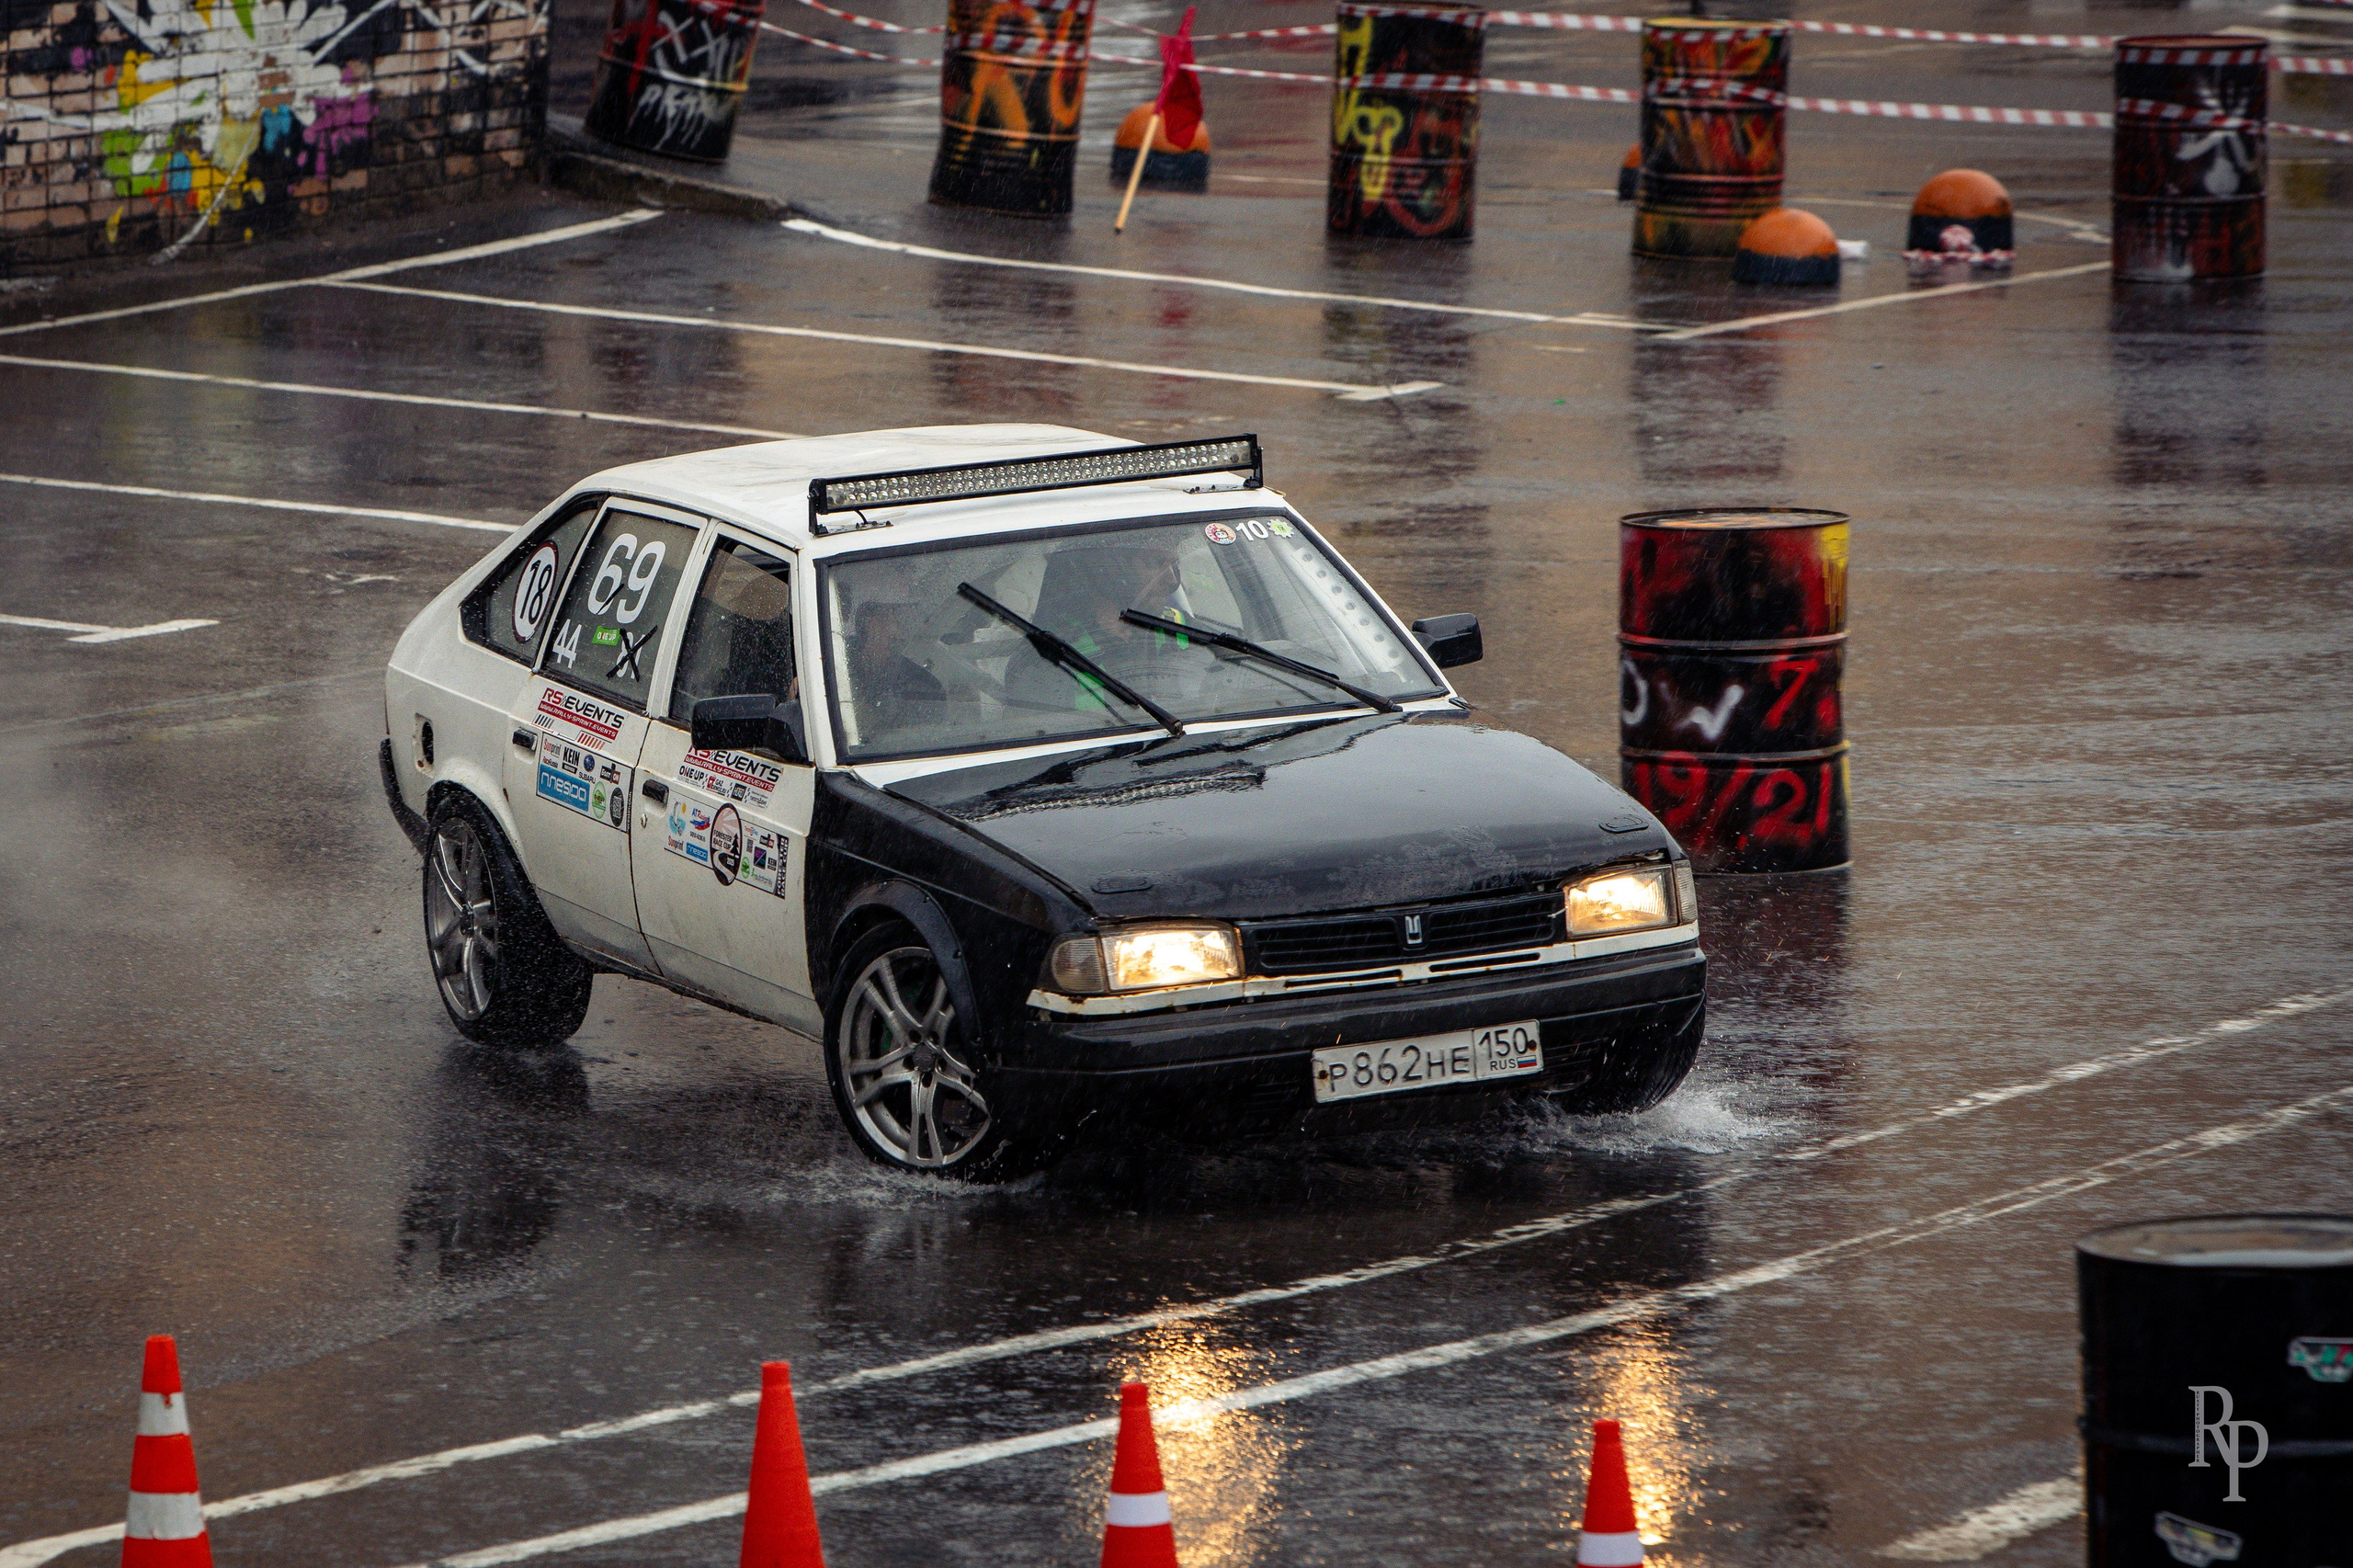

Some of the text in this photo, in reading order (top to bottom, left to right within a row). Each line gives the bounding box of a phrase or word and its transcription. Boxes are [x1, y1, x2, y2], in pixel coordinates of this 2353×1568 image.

[1235, 520, 1269, 541] 10
[588, 533, 665, 624] 69
[519, 560, 552, 625] 18
[551, 619, 582, 669] 44
[597, 631, 617, 642] ONE UP
[542, 687, 625, 729] RS EVENTS
[563, 746, 580, 767] KEIN
[714, 750, 781, 783] EVENTS
[578, 771, 597, 784] SUBARU
[679, 765, 705, 781] ONE UP
[713, 830, 733, 844] FORESTER
[713, 838, 733, 851] RACE CUP
[1478, 1027, 1529, 1059] 150
[1490, 1059, 1517, 1071] RUS
